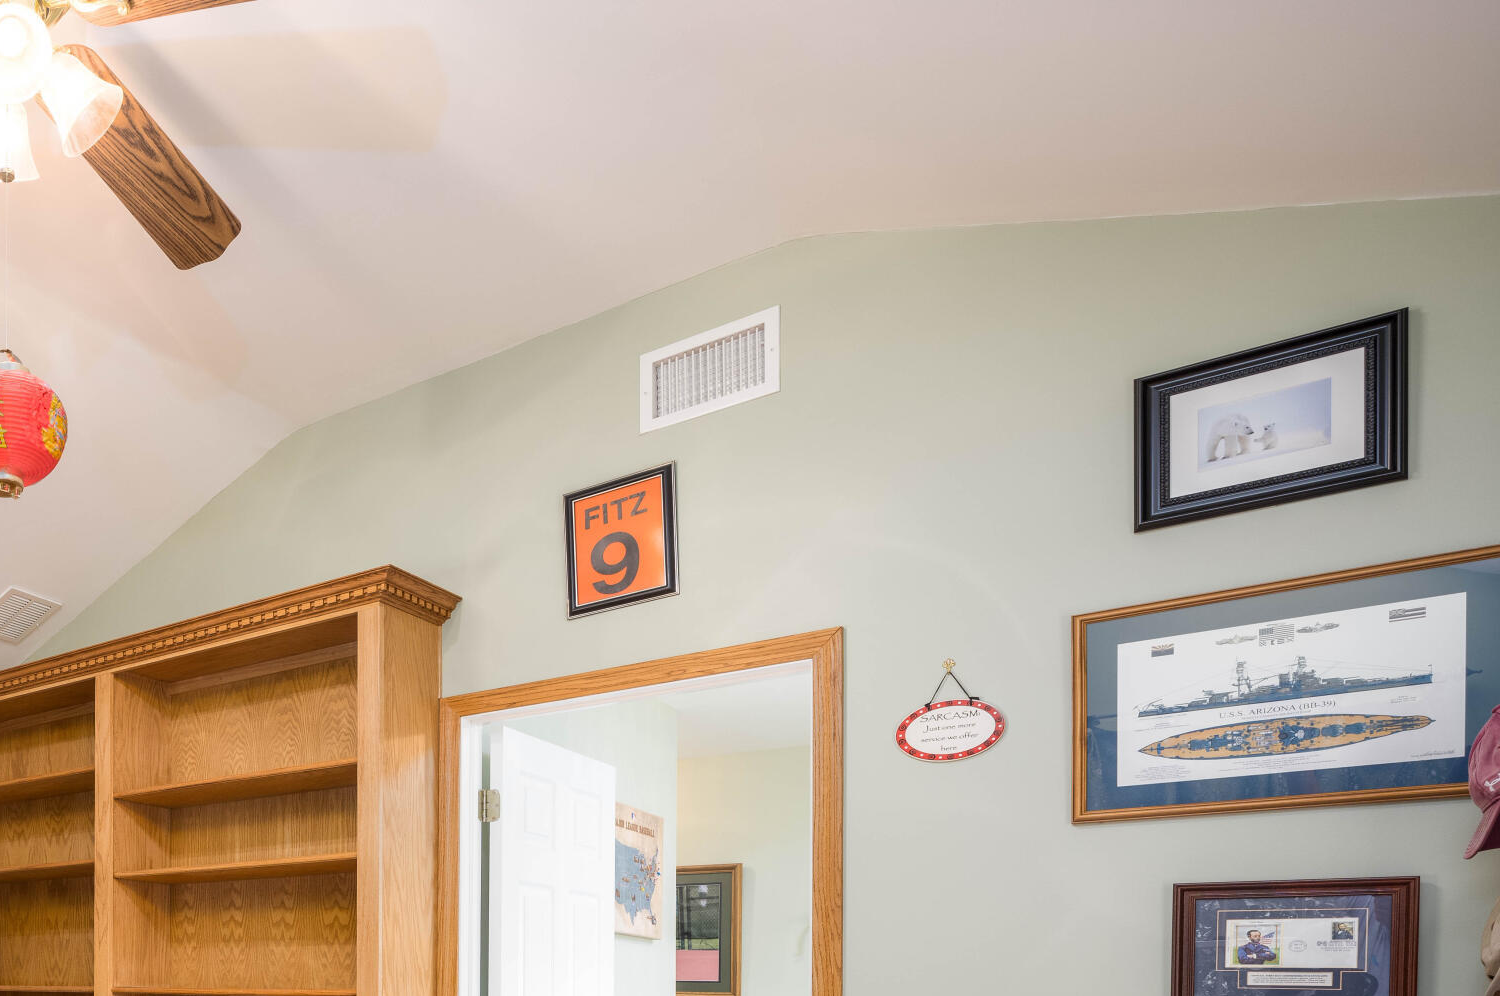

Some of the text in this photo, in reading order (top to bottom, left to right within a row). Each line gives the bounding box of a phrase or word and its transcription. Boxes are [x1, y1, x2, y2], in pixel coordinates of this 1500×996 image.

[584, 490, 648, 530] FITZ
[591, 532, 640, 594] 9
[1249, 703, 1297, 716] ARIZONA
